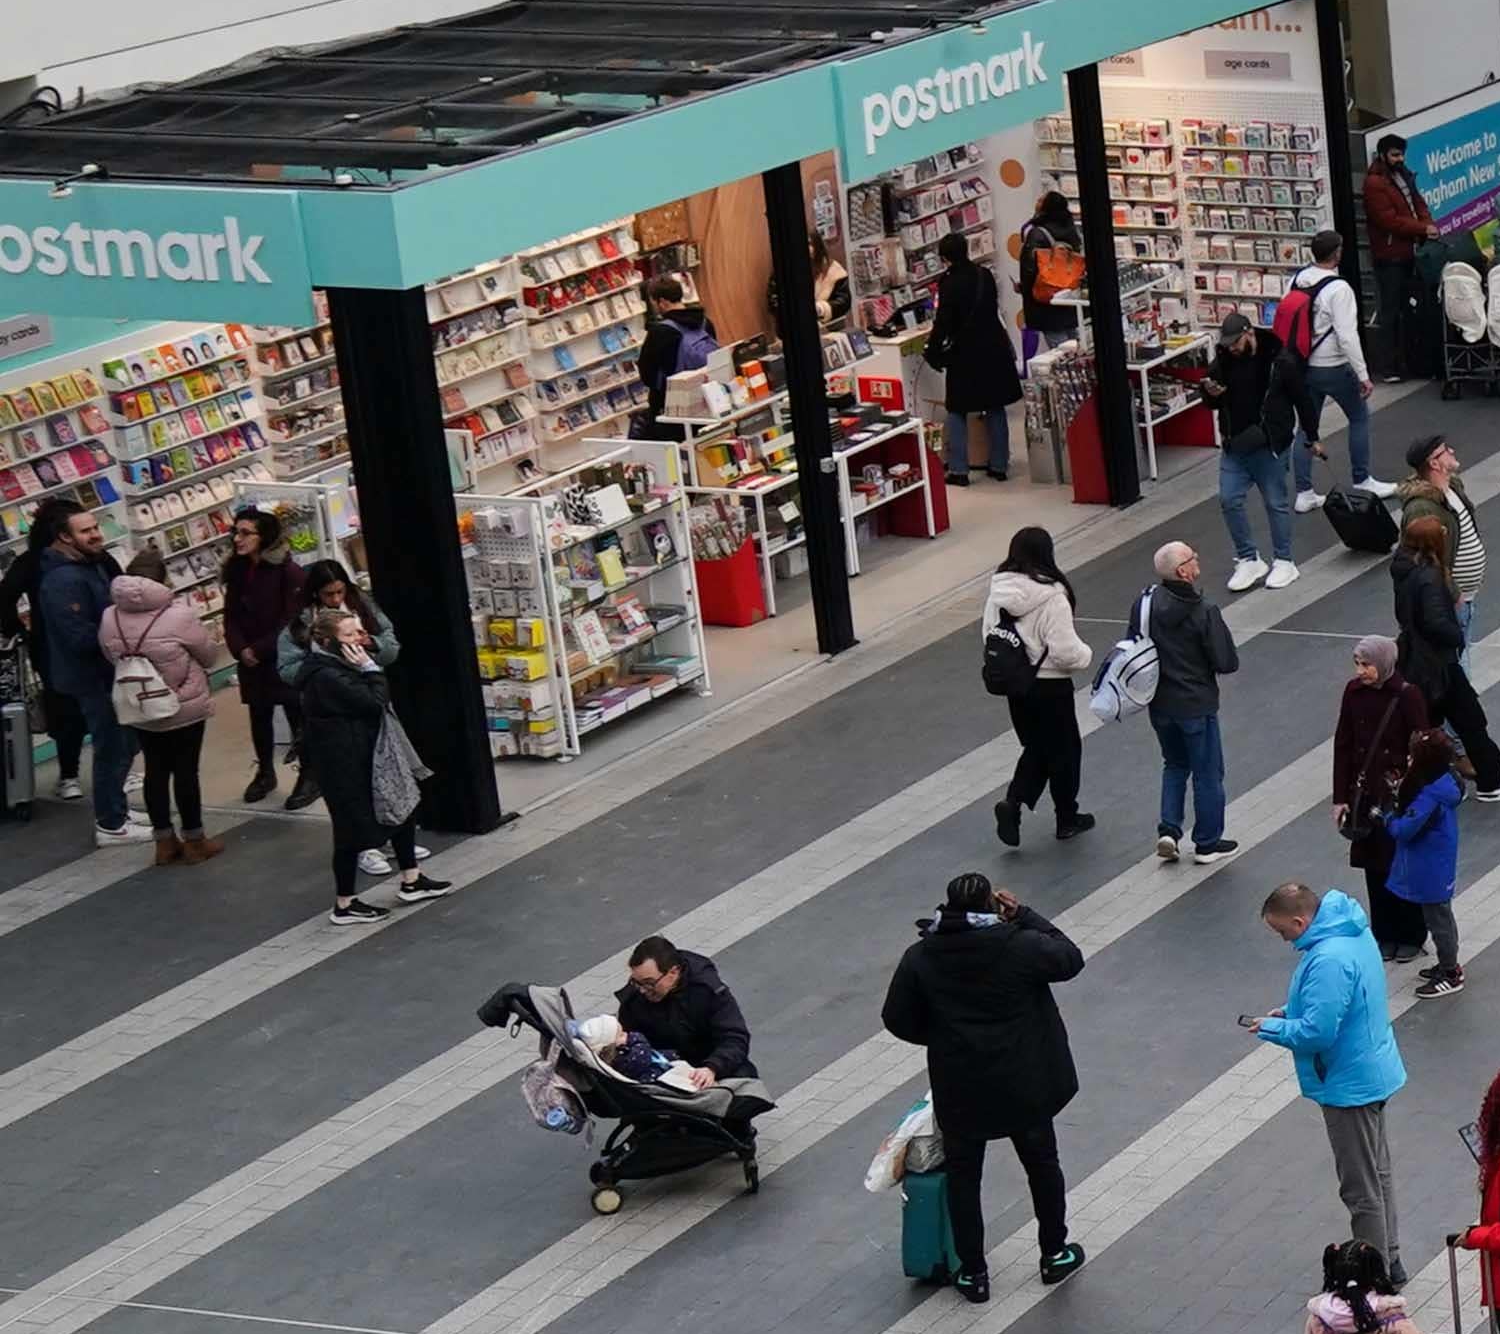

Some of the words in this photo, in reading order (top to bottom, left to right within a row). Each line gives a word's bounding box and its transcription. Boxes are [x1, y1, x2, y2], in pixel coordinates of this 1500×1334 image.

[1224, 58, 1242, 69] age
[1244, 57, 1271, 68] cards
[863, 30, 1049, 156] postmark
[1426, 137, 1482, 174] Welcome
[1483, 132, 1497, 151] to
[1420, 176, 1468, 209] ingham
[1470, 164, 1496, 187] New
[11, 323, 40, 342] cards
